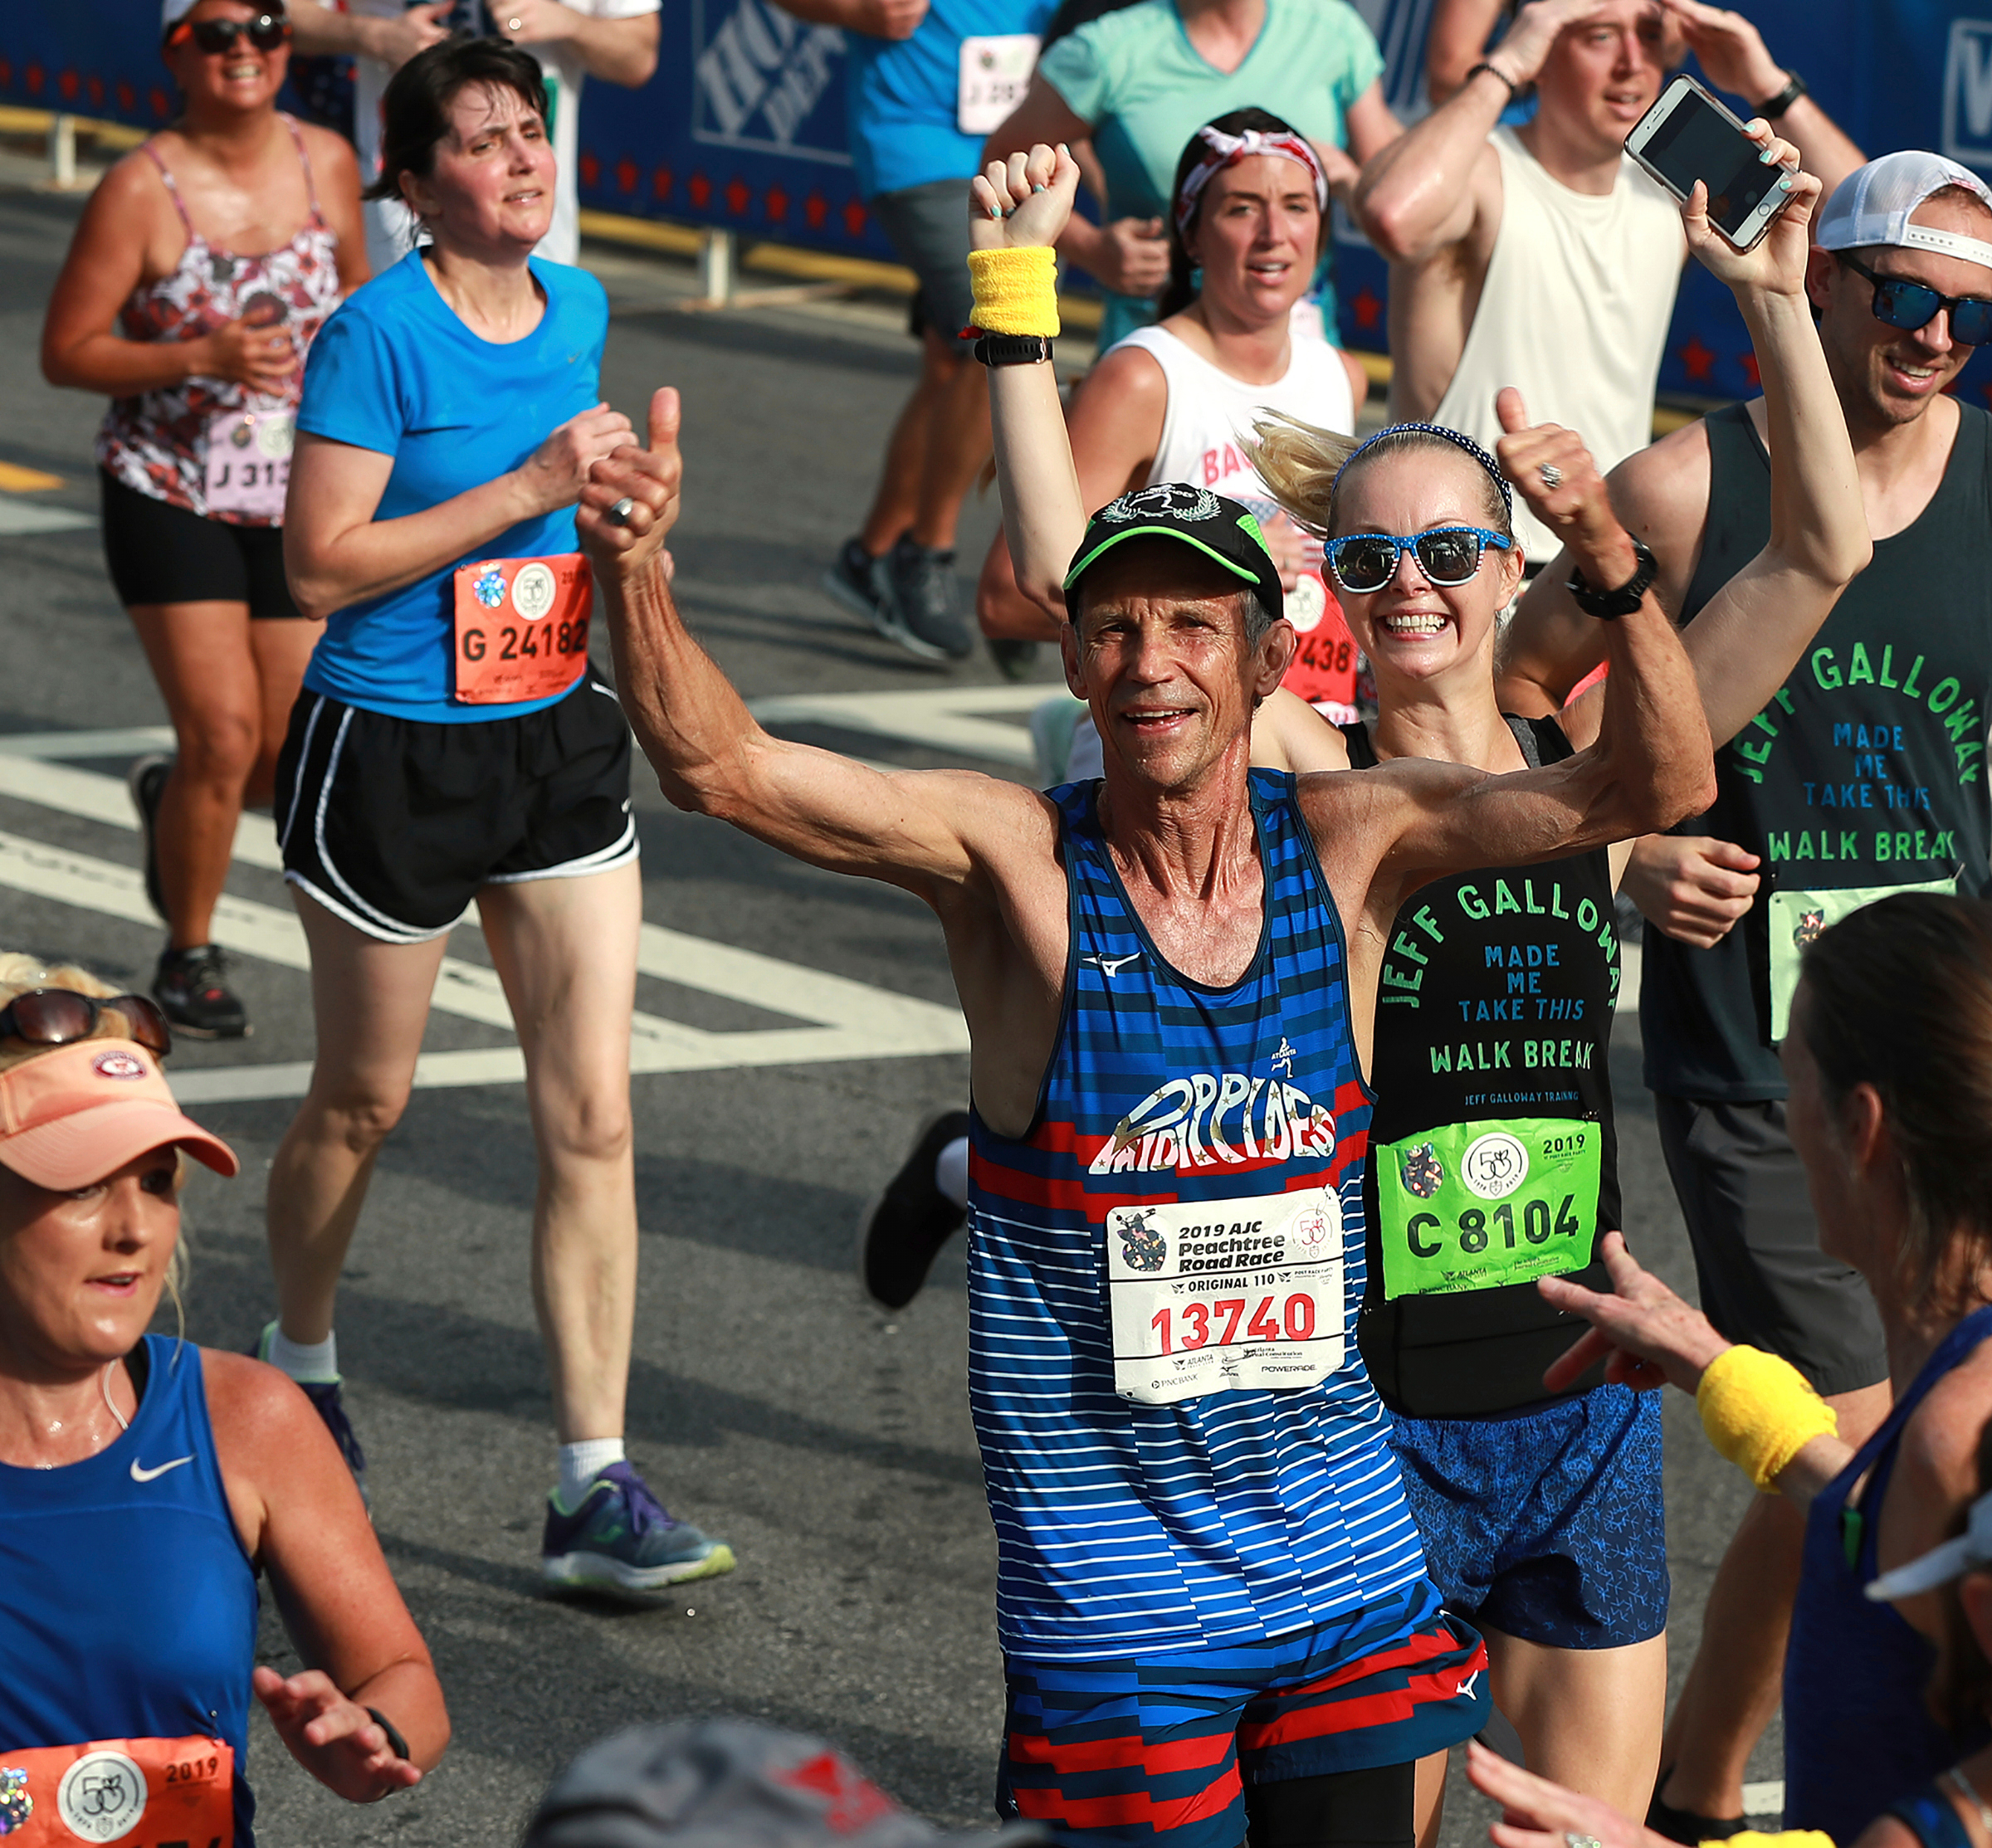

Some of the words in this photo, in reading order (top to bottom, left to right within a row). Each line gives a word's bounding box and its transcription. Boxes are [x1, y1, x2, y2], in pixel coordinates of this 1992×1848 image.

[462, 628, 486, 661] G
[500, 619, 587, 661] 24182
[1811, 641, 1984, 785] GALLOWAY
[1833, 723, 1904, 751] MADE
[1855, 753, 1887, 779] ME
[1803, 782, 1873, 808] TAKE
[1884, 785, 1931, 811] THIS
[1768, 830, 1859, 862] WALK
[1875, 829, 1958, 862] BREAK
[1382, 904, 1445, 1008] JEFF
[1484, 944, 1560, 968] MADE
[1507, 971, 1542, 994] ME
[1458, 998, 1525, 1022] TAKE
[1536, 998, 1584, 1021] THIS
[1429, 1041, 1511, 1074] WALK
[1524, 1039, 1594, 1070] BREAK
[1464, 1093, 1487, 1106] JEFF
[1490, 1091, 1542, 1104] GALLOWAY
[1543, 1134, 1585, 1154] 2019
[1179, 1224, 1225, 1239] 2019
[1228, 1221, 1262, 1235] AJC
[1407, 1212, 1443, 1258] C
[1458, 1193, 1579, 1254] 8104
[1179, 1235, 1285, 1256] Peachtree
[1179, 1255, 1233, 1272] Road
[1235, 1251, 1284, 1267] Race
[1189, 1277, 1248, 1292] ORIGINAL
[1254, 1273, 1275, 1286] 110
[1151, 1293, 1316, 1356] 13740
[167, 1758, 218, 1782] 2019
